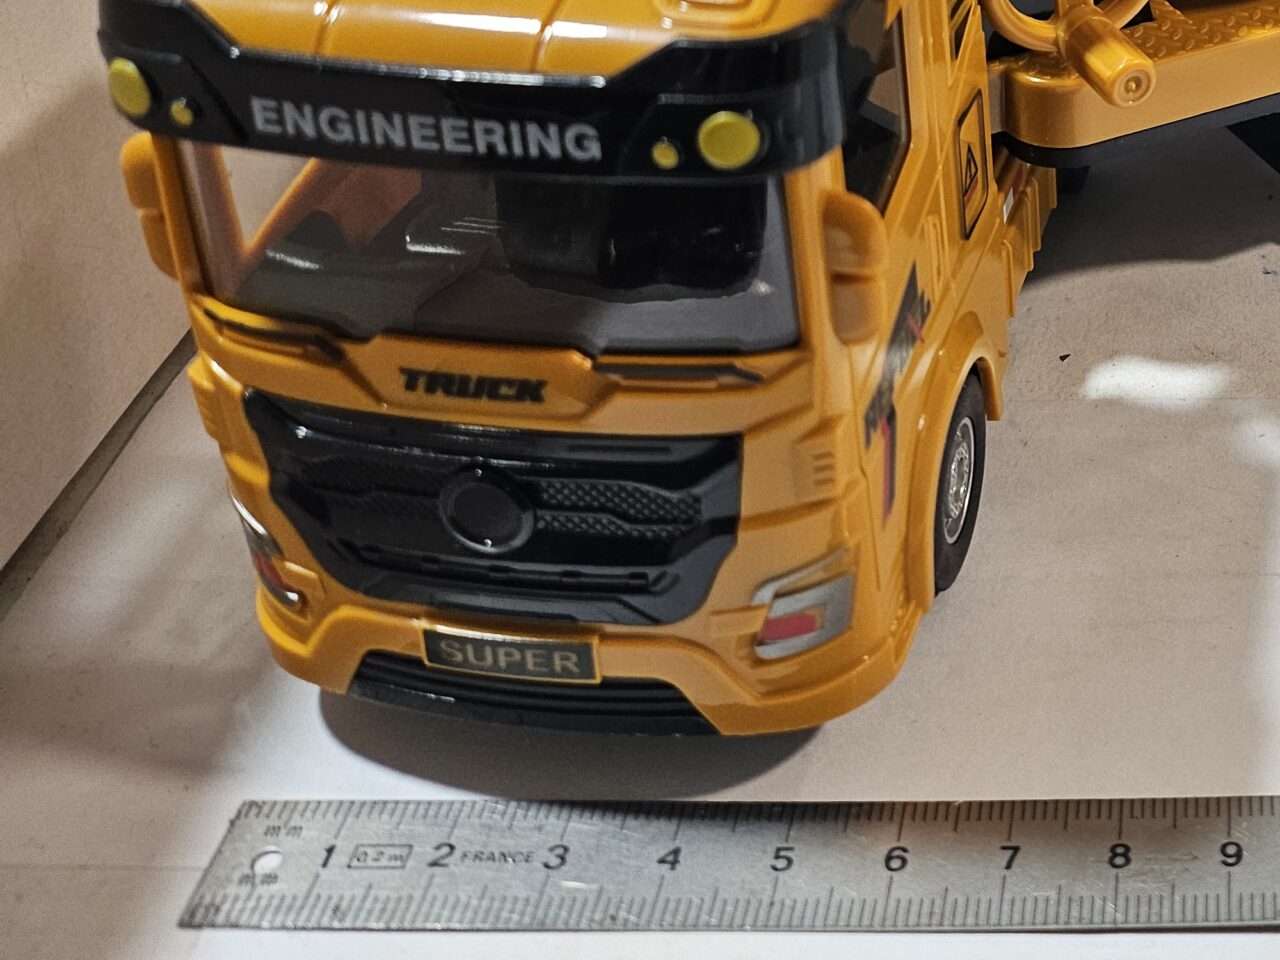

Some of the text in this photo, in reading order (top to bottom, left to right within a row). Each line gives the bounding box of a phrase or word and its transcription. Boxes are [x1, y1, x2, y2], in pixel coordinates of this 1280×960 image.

[252, 96, 602, 161] ENGINEERING
[399, 367, 548, 403] TRUCK
[440, 639, 580, 673] SUPER
[320, 844, 336, 868] 1
[427, 842, 456, 868] 2
[542, 844, 570, 870] 3
[657, 846, 682, 870] 4
[770, 846, 795, 872] 5
[883, 845, 910, 872] 6
[999, 844, 1022, 871] 7
[1107, 842, 1133, 870] 8
[1219, 840, 1244, 868] 9
[460, 850, 537, 864] FRANCE
